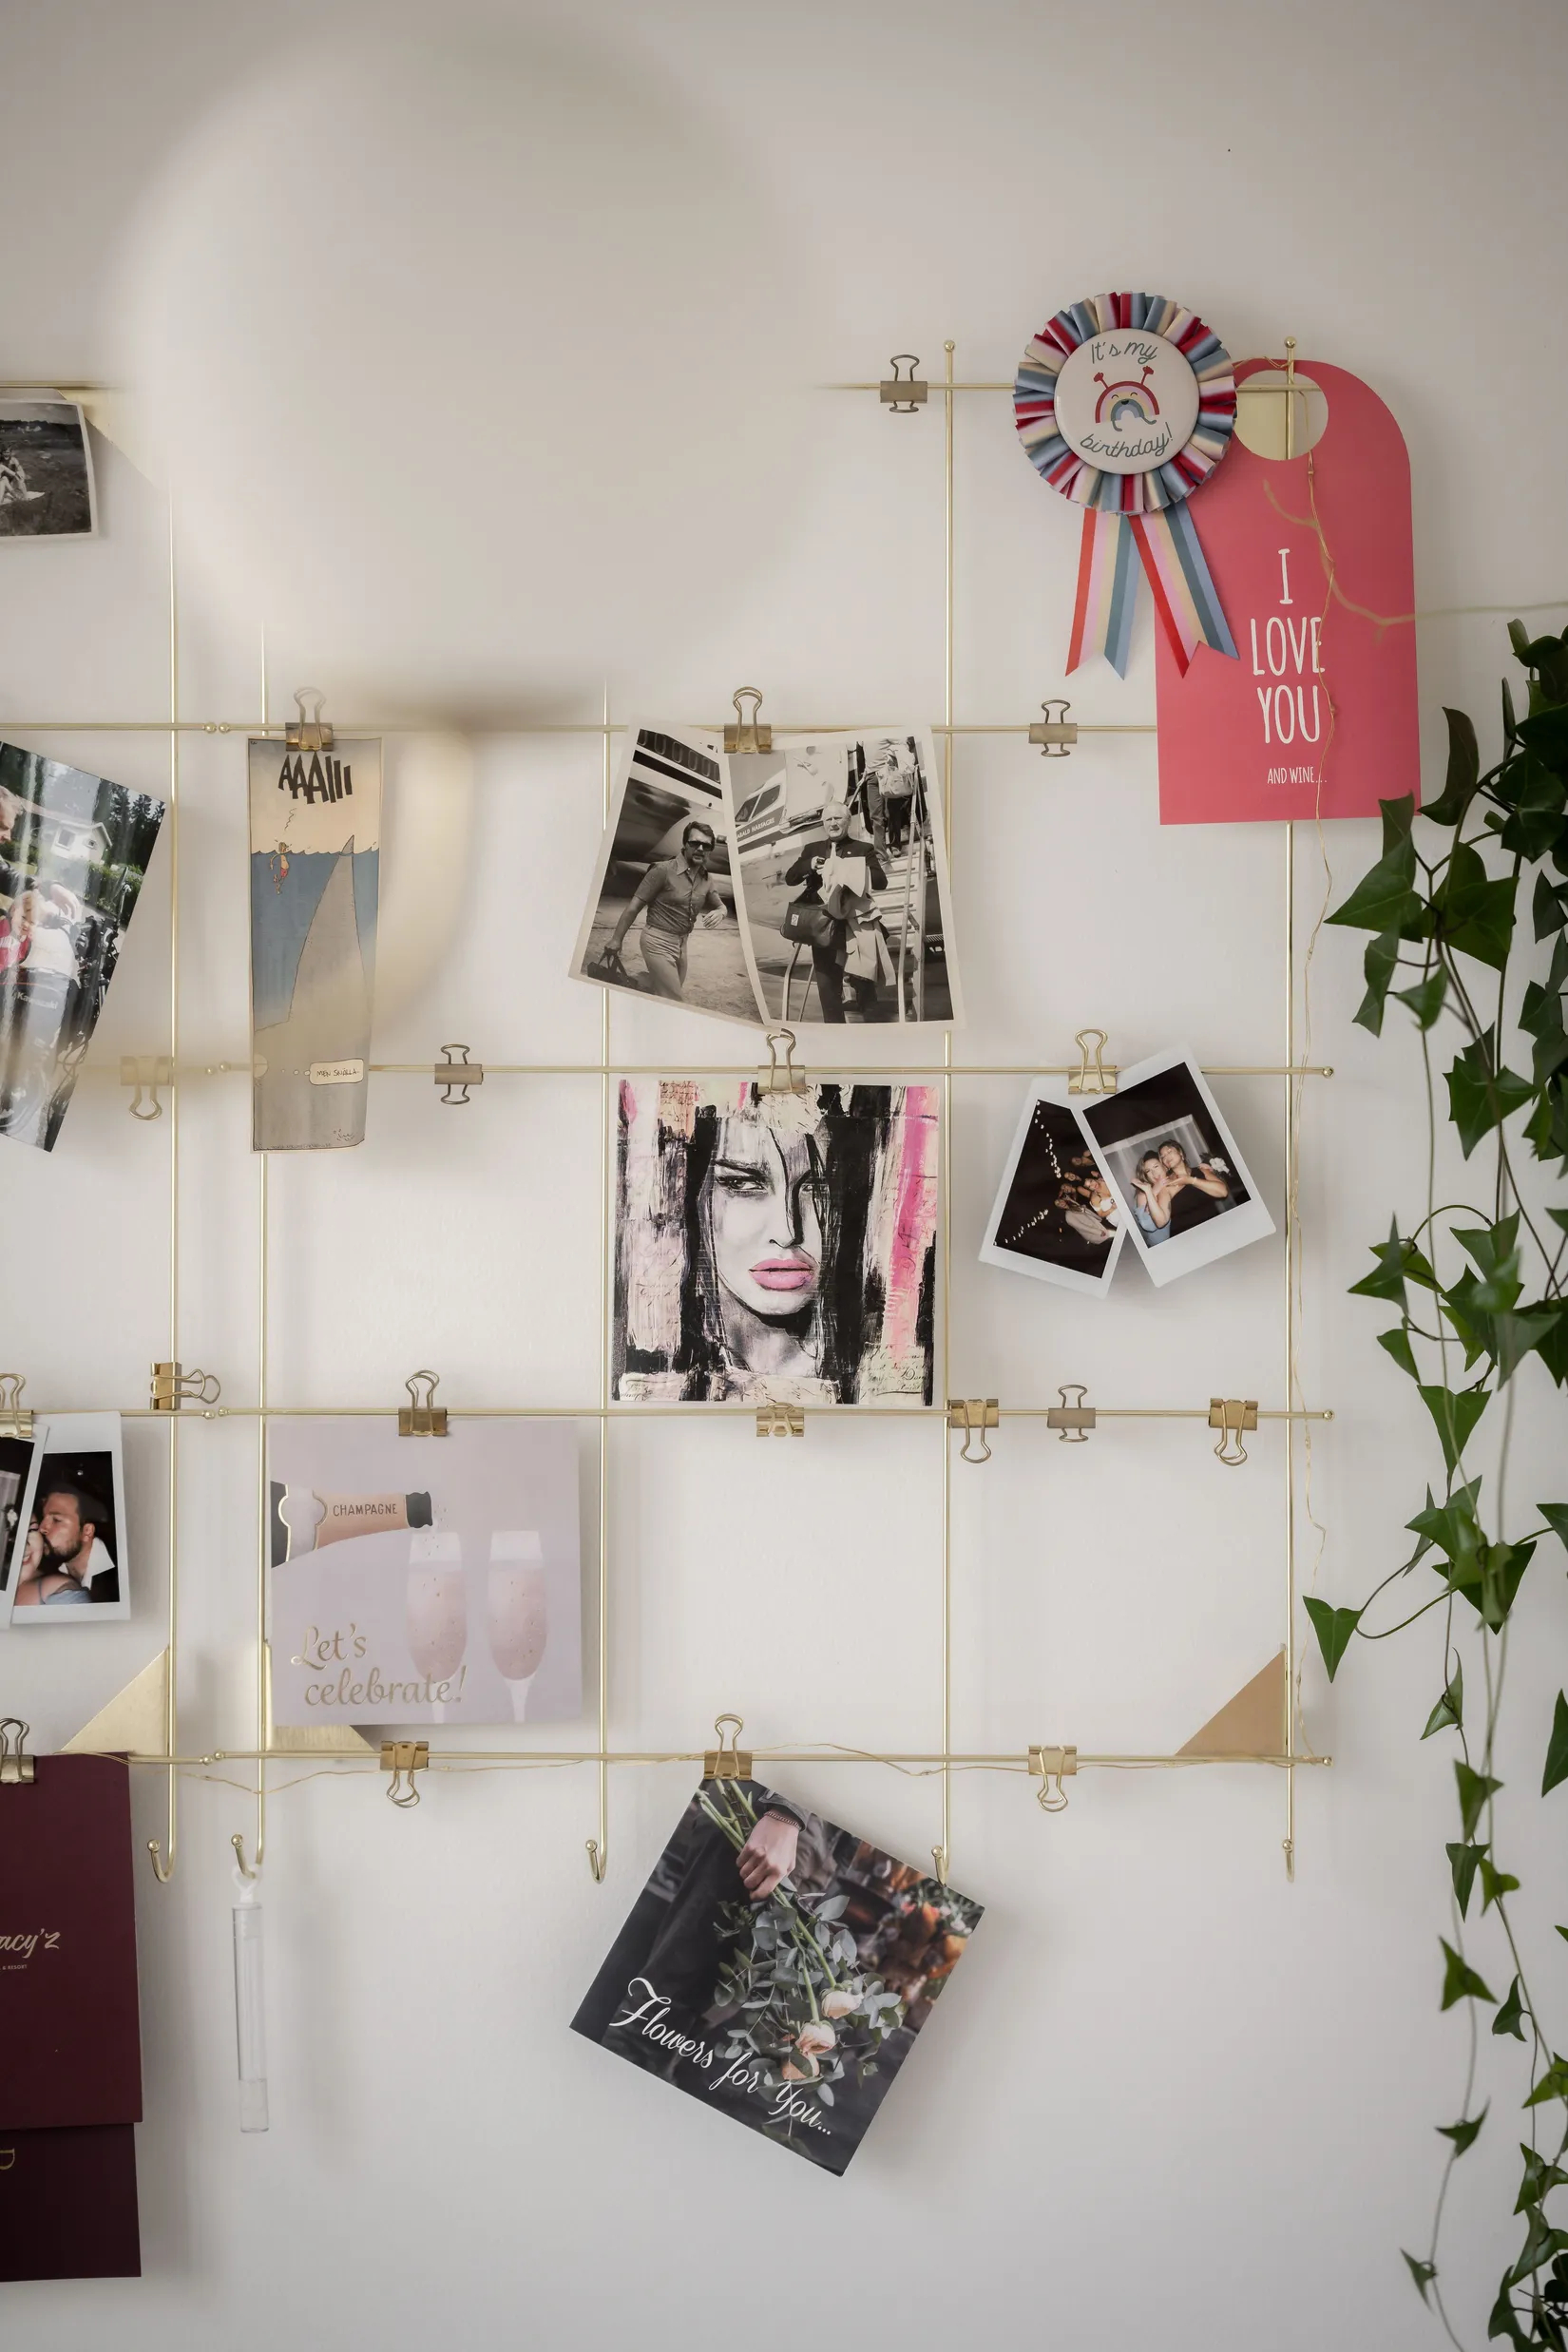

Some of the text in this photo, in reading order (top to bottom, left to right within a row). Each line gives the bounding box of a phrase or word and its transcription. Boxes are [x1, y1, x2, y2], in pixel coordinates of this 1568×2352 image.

[1091, 341, 1158, 365] It's my
[1080, 421, 1174, 458] birthday!
[1277, 548, 1293, 604] I
[1250, 616, 1326, 677] LOVE
[1256, 684, 1320, 744] YOU
[1267, 767, 1288, 785] AND
[333, 1502, 398, 1517] CHAMPAGNE
[291, 1623, 367, 1671] Let's
[304, 1665, 468, 1707] celebrate!
[609, 1977, 715, 2069] Flowers
[709, 2052, 760, 2094] for
